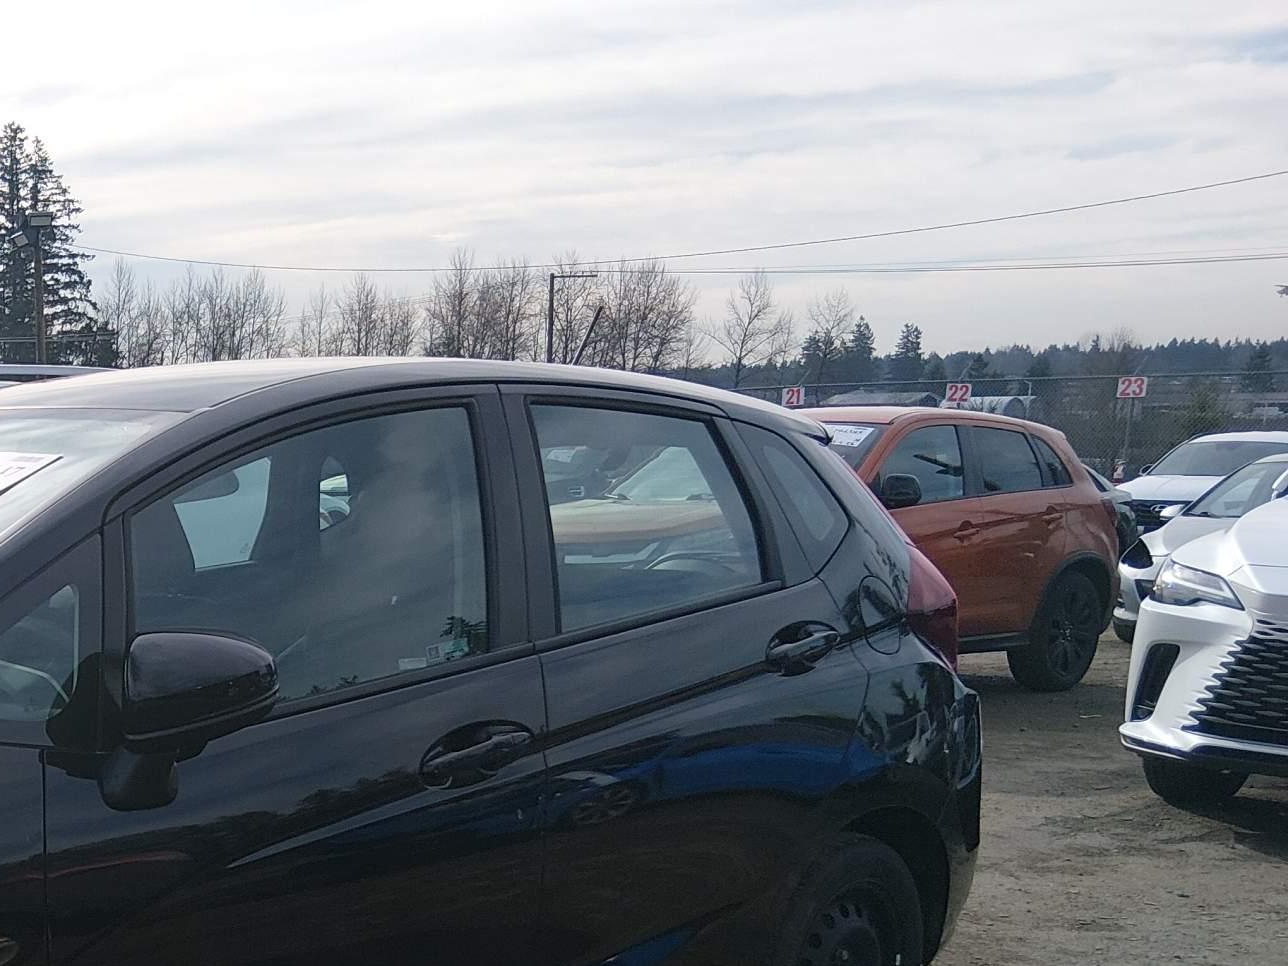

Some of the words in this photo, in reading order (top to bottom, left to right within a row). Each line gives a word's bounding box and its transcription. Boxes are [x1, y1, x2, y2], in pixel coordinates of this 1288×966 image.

[948, 385, 969, 402] 22
[1121, 379, 1144, 396] 23
[786, 389, 801, 404] 21
